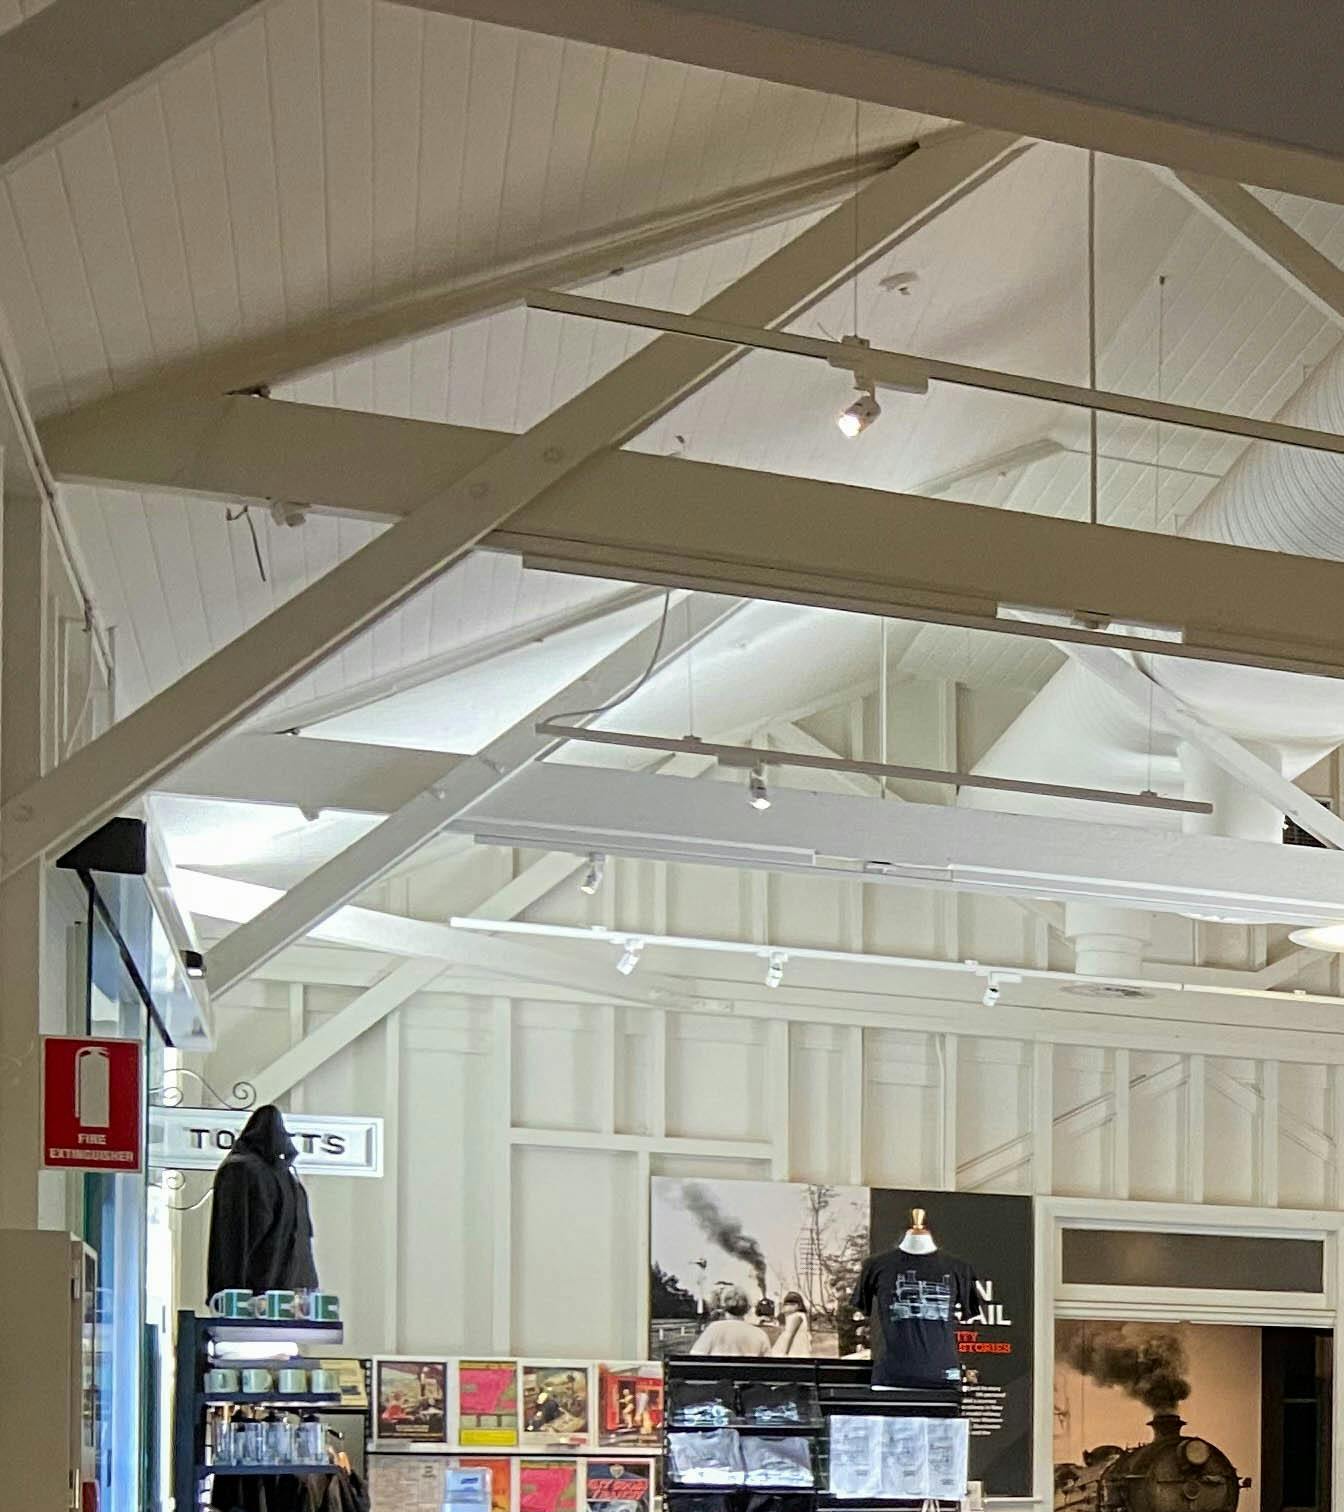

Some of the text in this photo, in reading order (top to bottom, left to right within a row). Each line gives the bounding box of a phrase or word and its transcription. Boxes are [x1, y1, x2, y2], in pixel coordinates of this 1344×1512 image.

[78, 1134, 106, 1145] FIRE
[190, 1128, 346, 1155] TOTS
[50, 1148, 134, 1162] EXTINGUISHER
